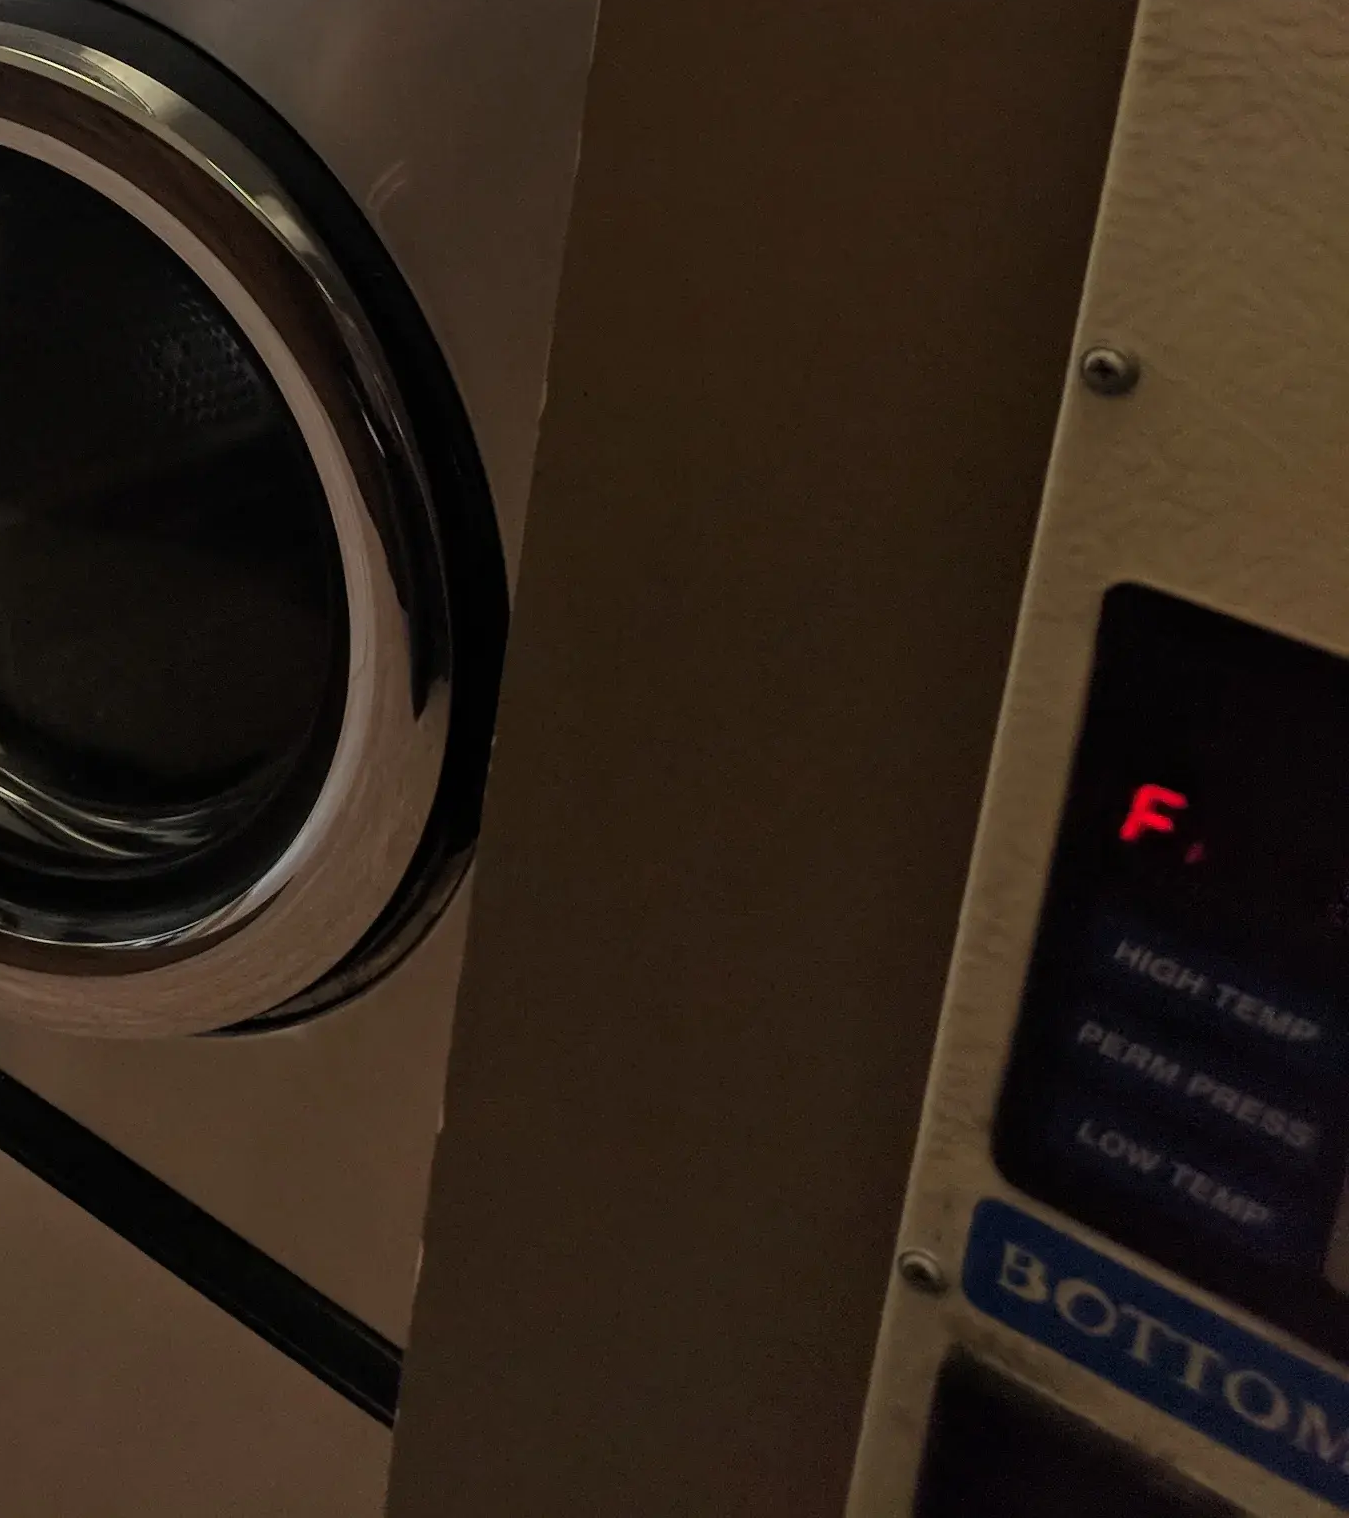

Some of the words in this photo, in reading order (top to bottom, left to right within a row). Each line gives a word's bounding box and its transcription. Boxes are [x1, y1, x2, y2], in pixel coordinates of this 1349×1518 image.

[1113, 938, 1209, 995] HIGH
[1214, 982, 1321, 1041] TEMP
[1076, 1019, 1182, 1086] PERM
[1186, 1073, 1316, 1150] PRESS
[1076, 1119, 1162, 1172] LOW
[1169, 1158, 1270, 1224] TEMP
